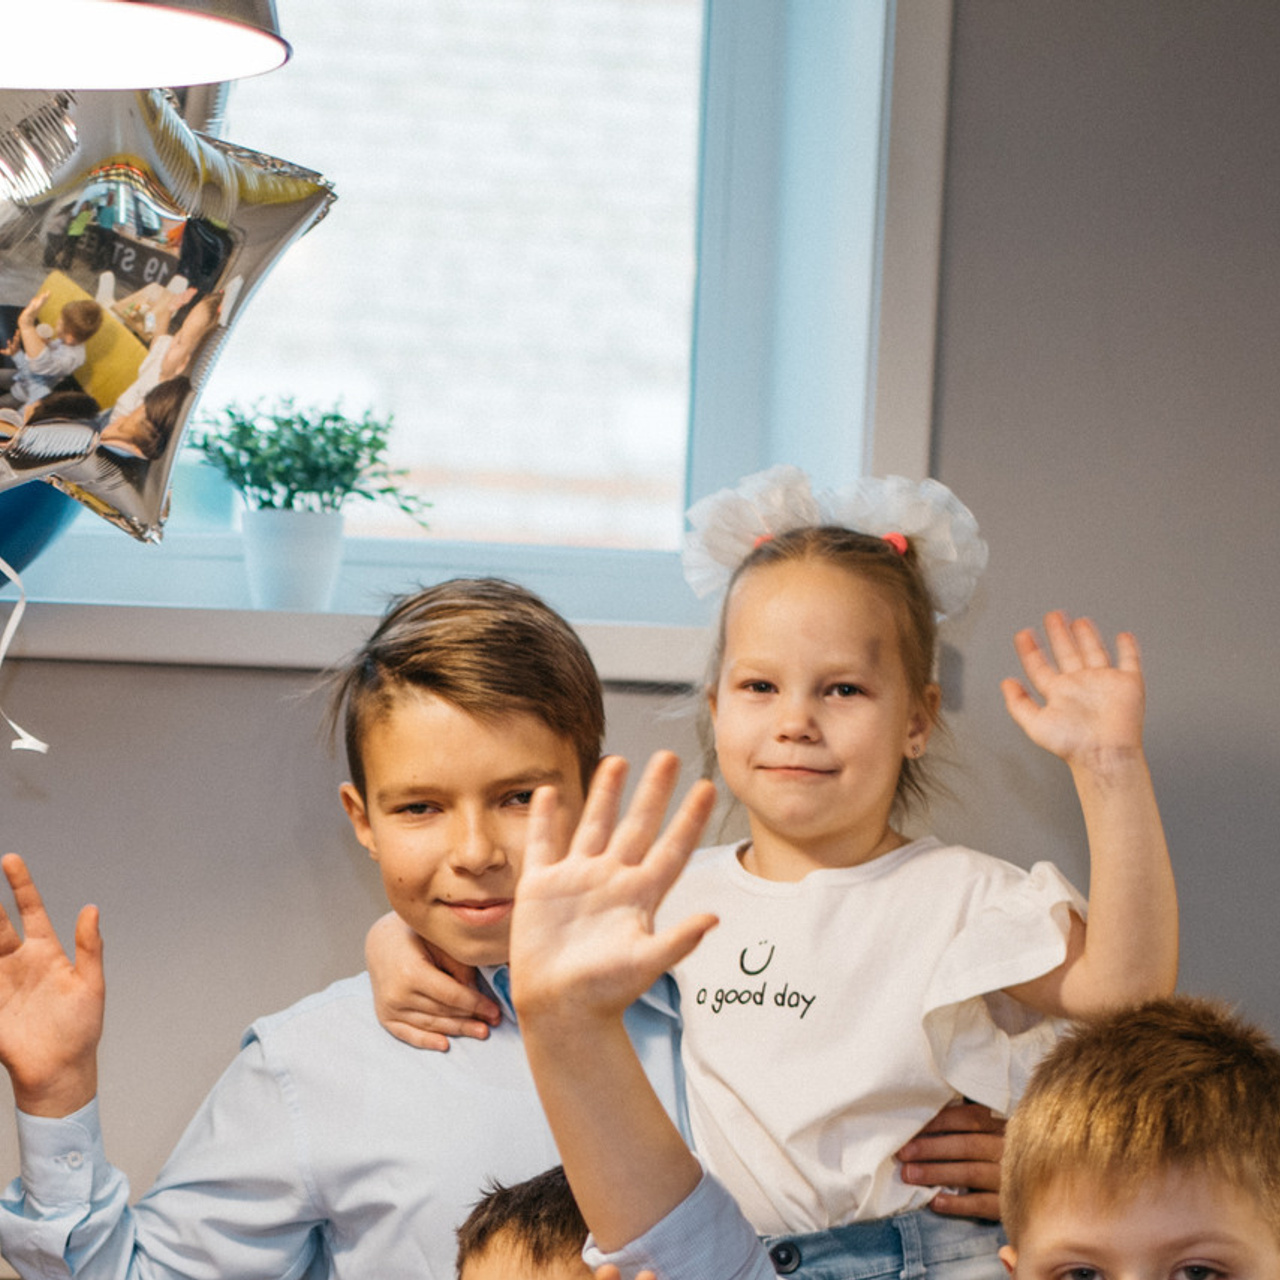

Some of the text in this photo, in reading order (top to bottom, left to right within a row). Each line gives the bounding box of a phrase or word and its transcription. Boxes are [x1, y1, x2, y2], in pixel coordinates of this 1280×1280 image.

[696, 982, 816, 1019] a good day
